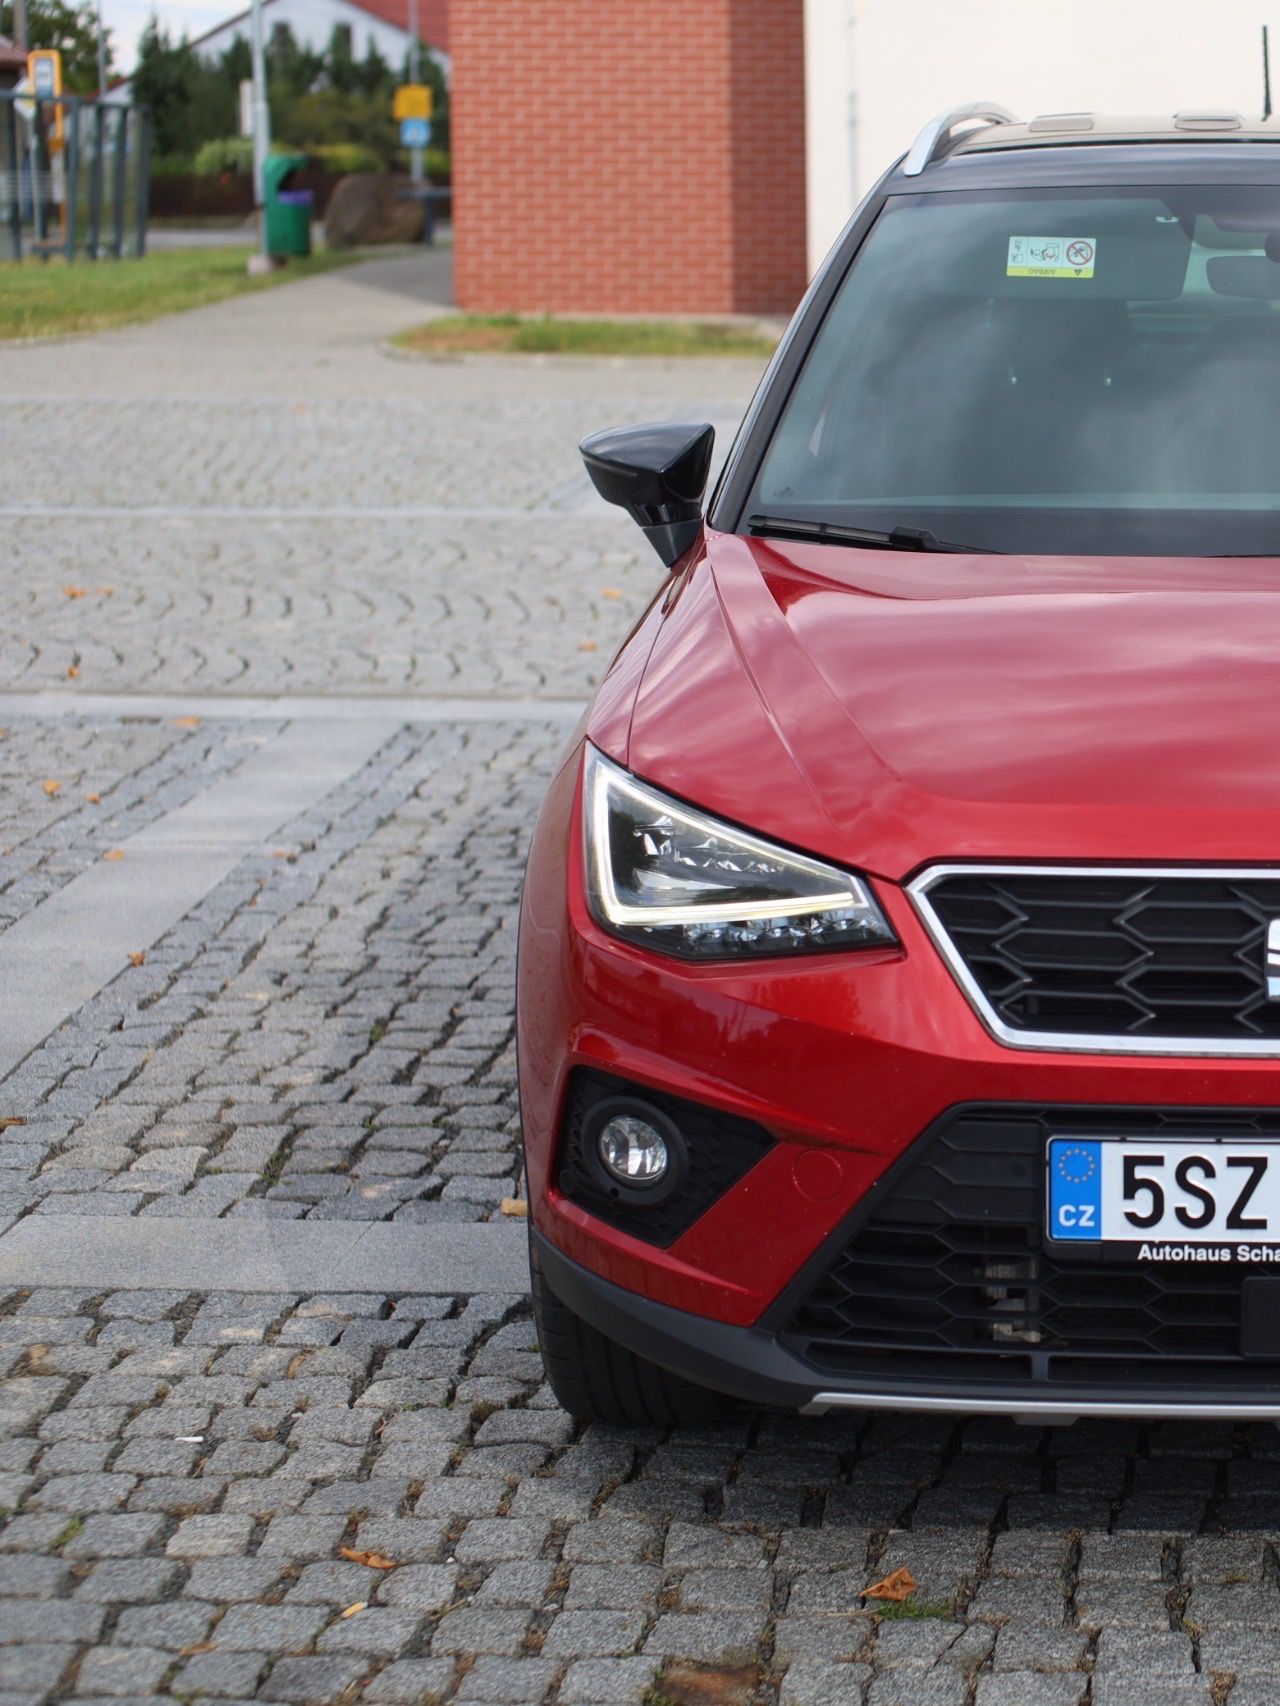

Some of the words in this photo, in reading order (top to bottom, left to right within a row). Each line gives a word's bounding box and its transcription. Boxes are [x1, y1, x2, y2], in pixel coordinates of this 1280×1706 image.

[1123, 1155, 1268, 1230] 5SZ
[1058, 1204, 1095, 1227] CZ
[1137, 1244, 1231, 1261] Autohaus
